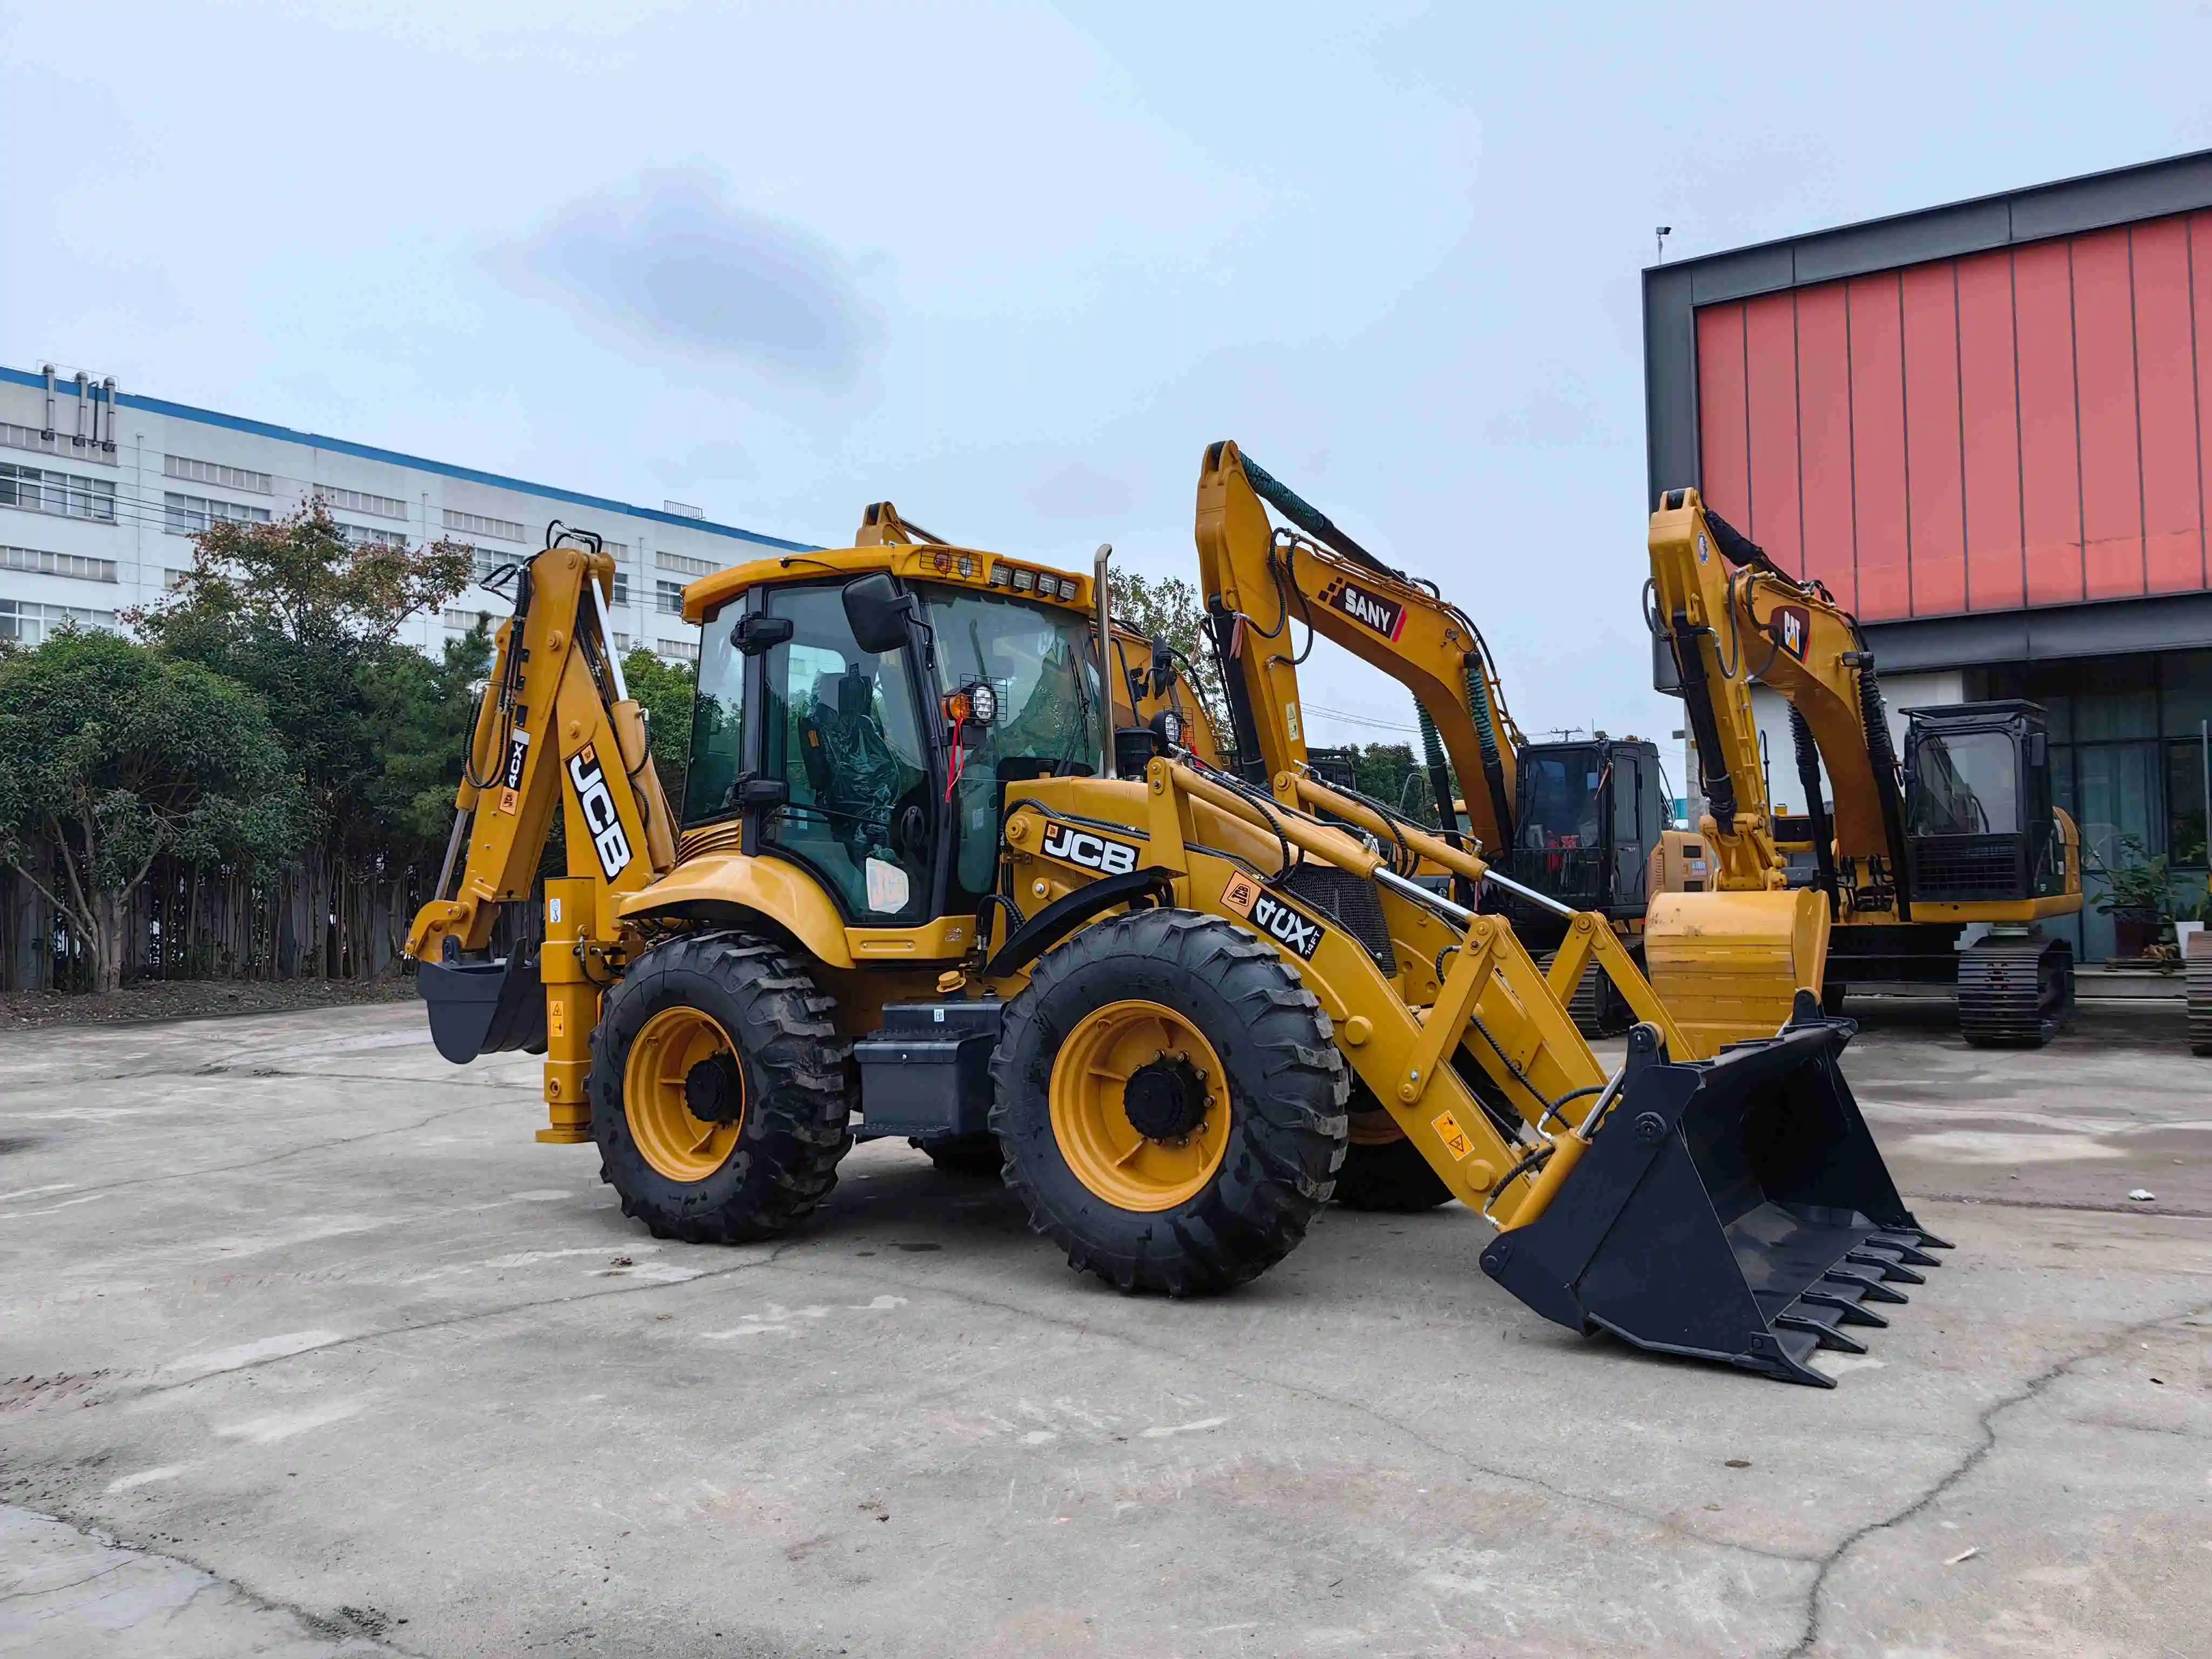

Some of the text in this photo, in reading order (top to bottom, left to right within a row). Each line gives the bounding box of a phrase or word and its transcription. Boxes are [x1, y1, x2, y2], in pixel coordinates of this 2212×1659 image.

[1345, 588, 1391, 632] SANY
[1784, 610, 1800, 654] CAT
[509, 742, 524, 788] 4CX
[570, 754, 630, 877] JCB
[1044, 829, 1136, 875] JCB
[1231, 886, 1249, 904] JCB
[1256, 897, 1316, 954] 4CX
[1305, 929, 1320, 955] 14FT
